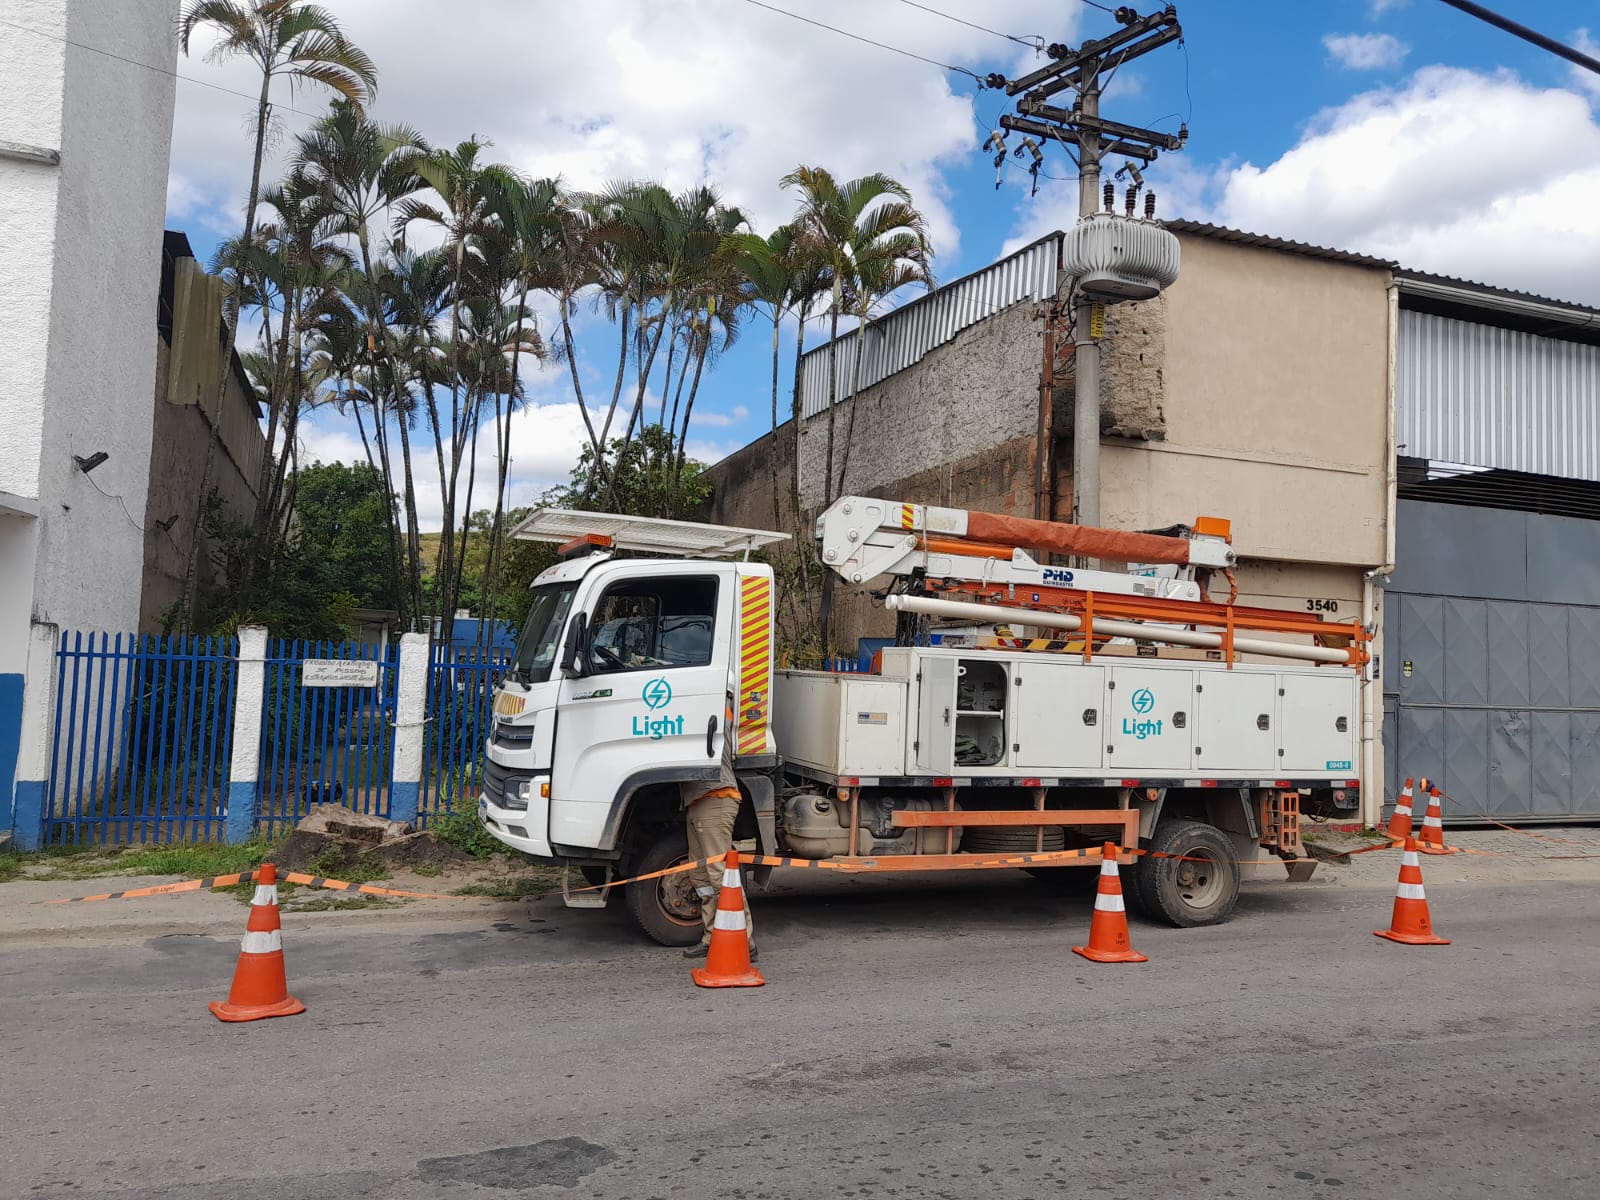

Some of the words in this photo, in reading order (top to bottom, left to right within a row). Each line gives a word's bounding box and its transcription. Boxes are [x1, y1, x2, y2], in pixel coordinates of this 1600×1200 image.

[1043, 569, 1074, 582] PHD
[1306, 599, 1338, 613] 3540
[632, 715, 685, 740] Light
[1122, 717, 1163, 740] Light
